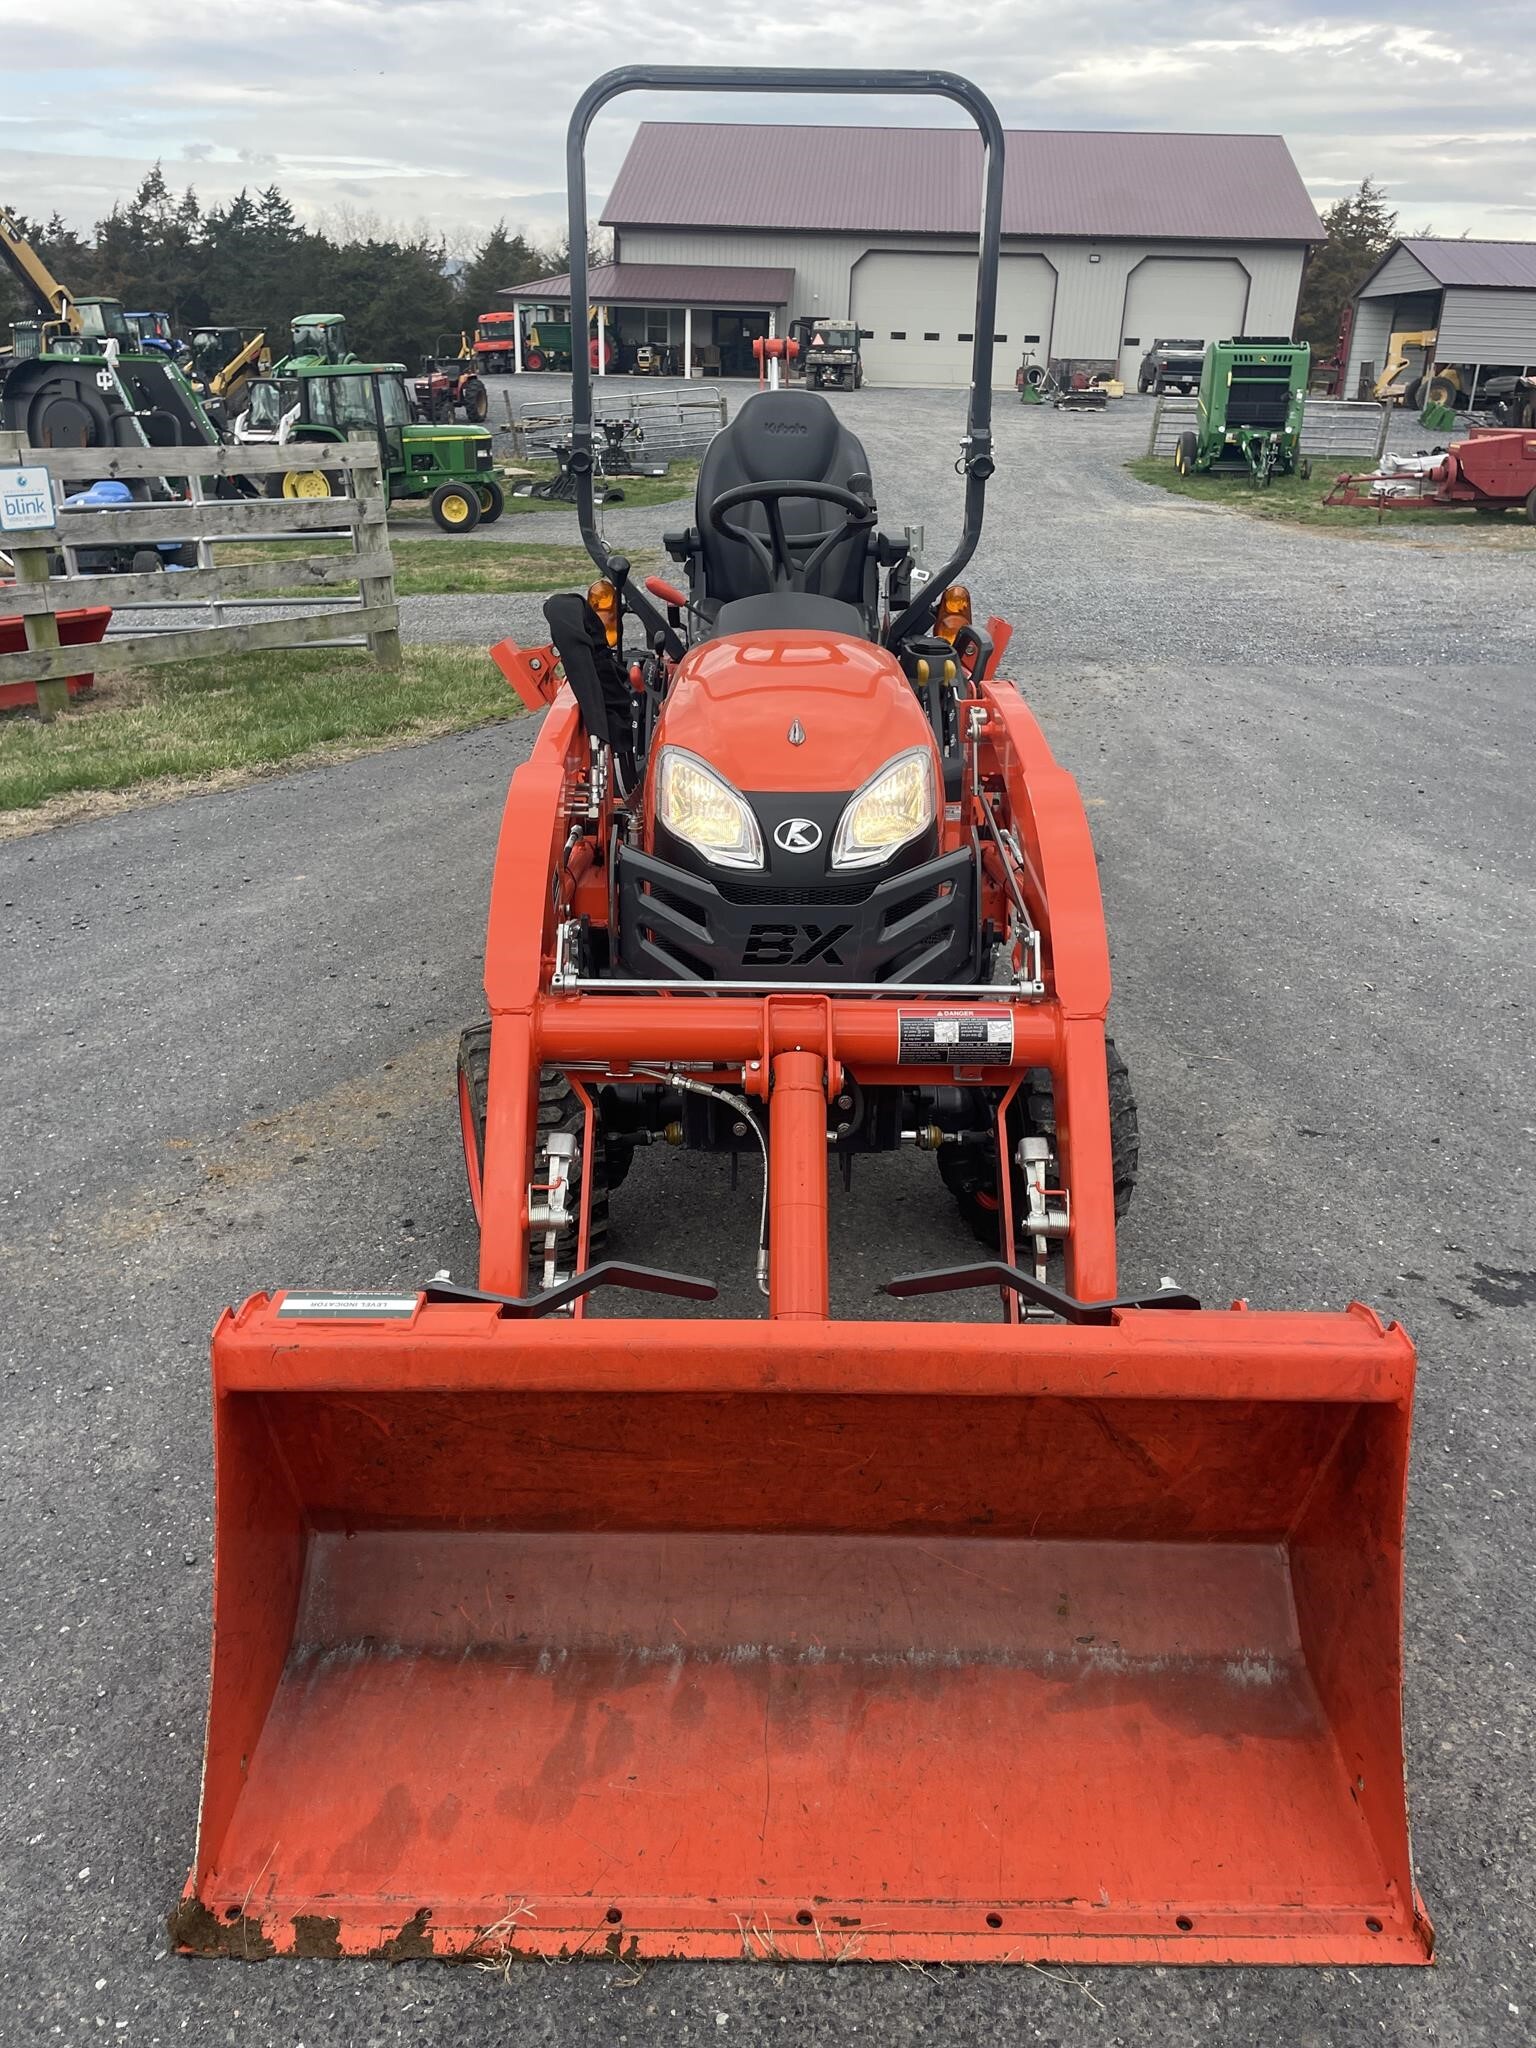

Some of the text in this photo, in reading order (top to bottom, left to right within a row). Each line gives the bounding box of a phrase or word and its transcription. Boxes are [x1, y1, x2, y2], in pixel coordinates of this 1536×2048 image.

[763, 421, 808, 435] Kubota
[4, 497, 46, 515] blink
[782, 820, 813, 848] K
[741, 924, 854, 967] BX
